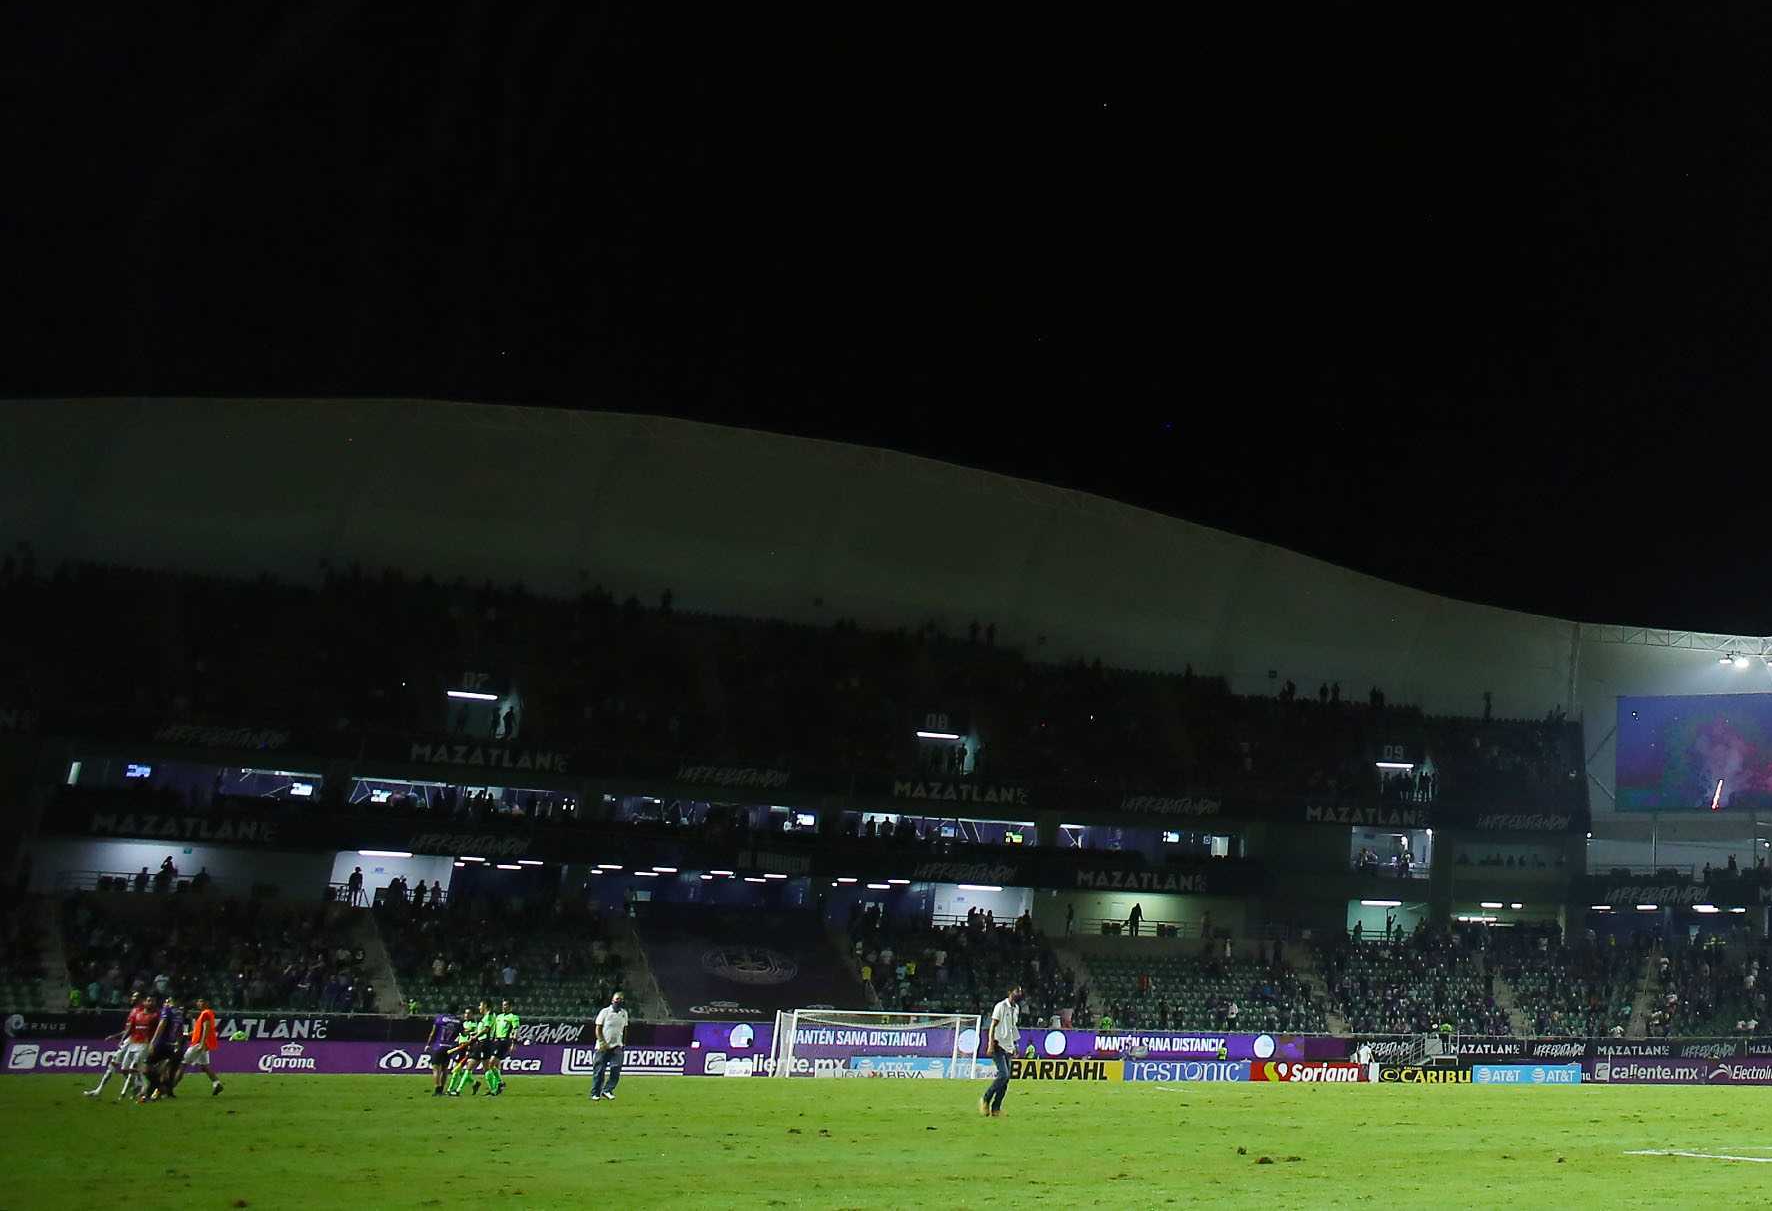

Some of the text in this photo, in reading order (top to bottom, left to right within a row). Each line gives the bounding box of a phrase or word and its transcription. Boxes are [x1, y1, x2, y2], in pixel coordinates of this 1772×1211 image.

[837, 1030, 869, 1046] SANA
[870, 1031, 927, 1047] DISTANCIA
[258, 1053, 316, 1073] Corona
[1009, 1060, 1108, 1081] BARDAHL
[1611, 1063, 1698, 1080] caliente.mx
[1291, 1063, 1358, 1083] Soriana
[1400, 1069, 1472, 1084] CARIBU
[1491, 1069, 1521, 1082] AT&T
[1545, 1069, 1575, 1082] AT&T
